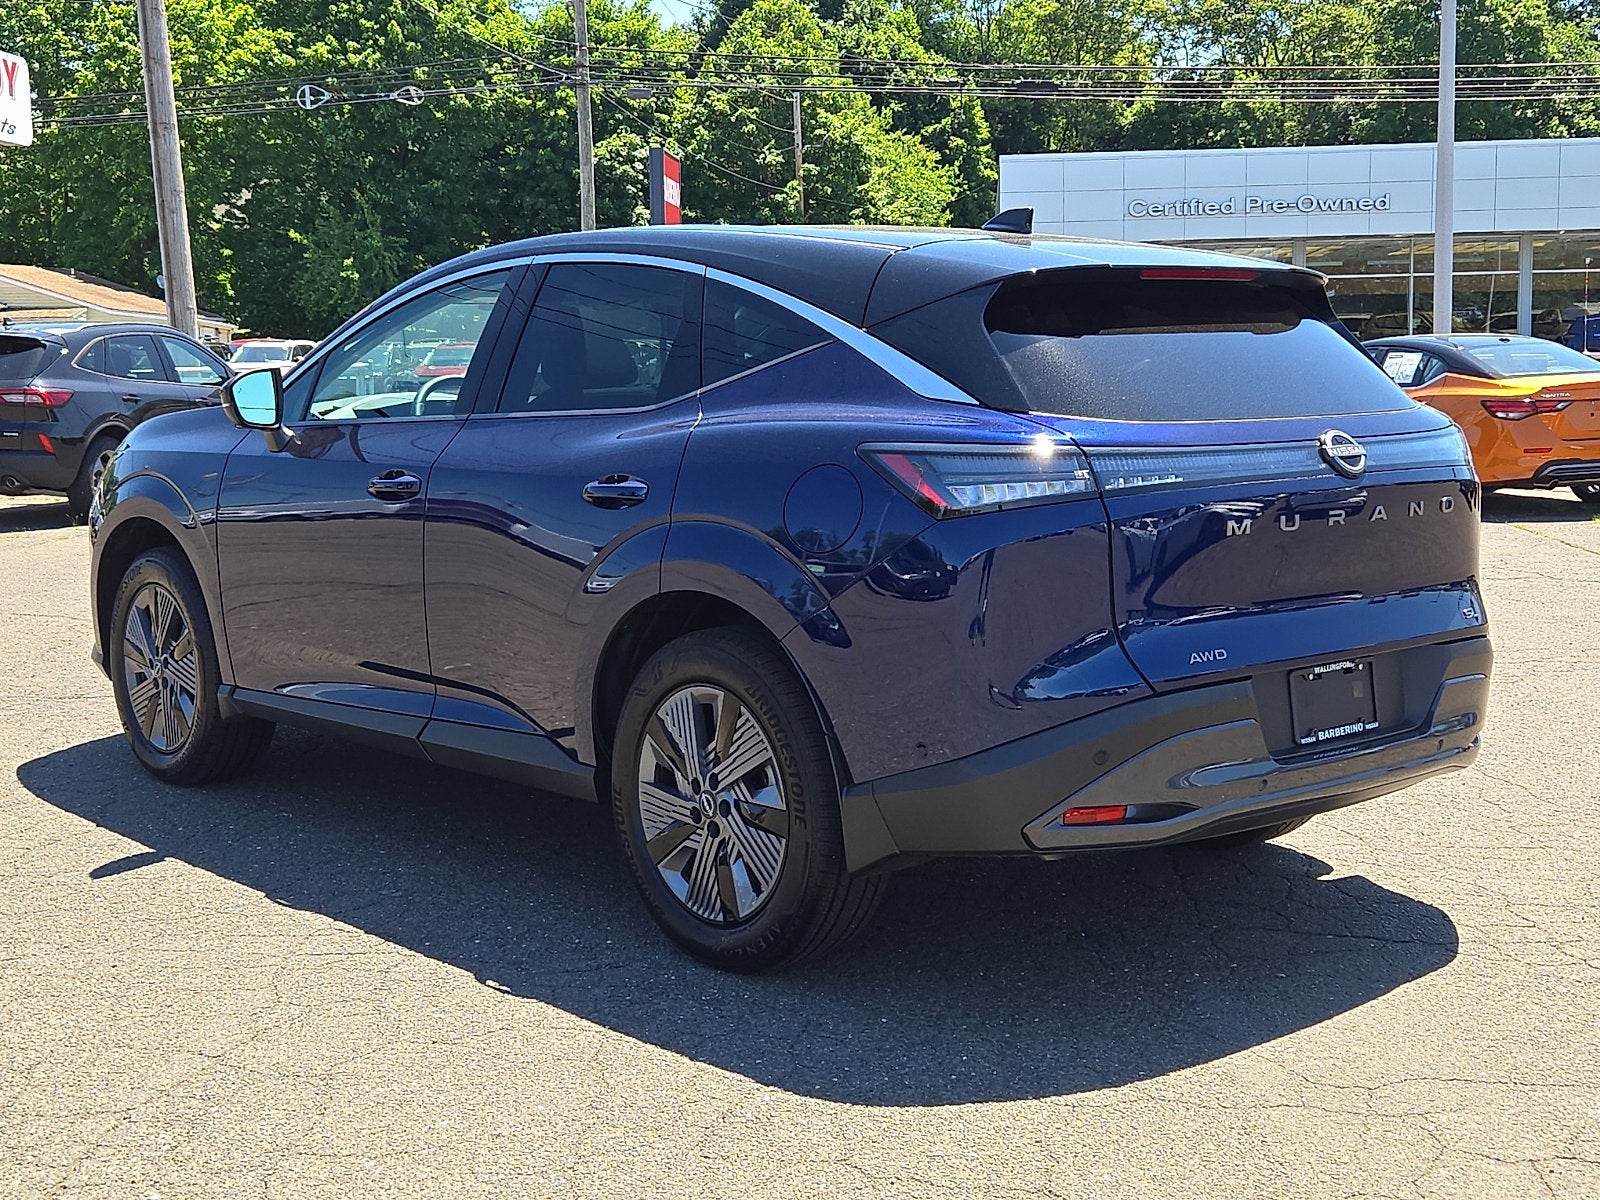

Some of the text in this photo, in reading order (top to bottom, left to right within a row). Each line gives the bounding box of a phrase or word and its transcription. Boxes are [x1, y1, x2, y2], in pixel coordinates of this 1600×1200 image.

[0, 58, 19, 100] Y
[1129, 193, 1391, 217] Certified Pre-Owned
[1328, 446, 1366, 456] NISSAN
[1226, 496, 1455, 536] MURANO
[1189, 648, 1228, 665] AWD
[1318, 723, 1364, 740] BARBERINO
